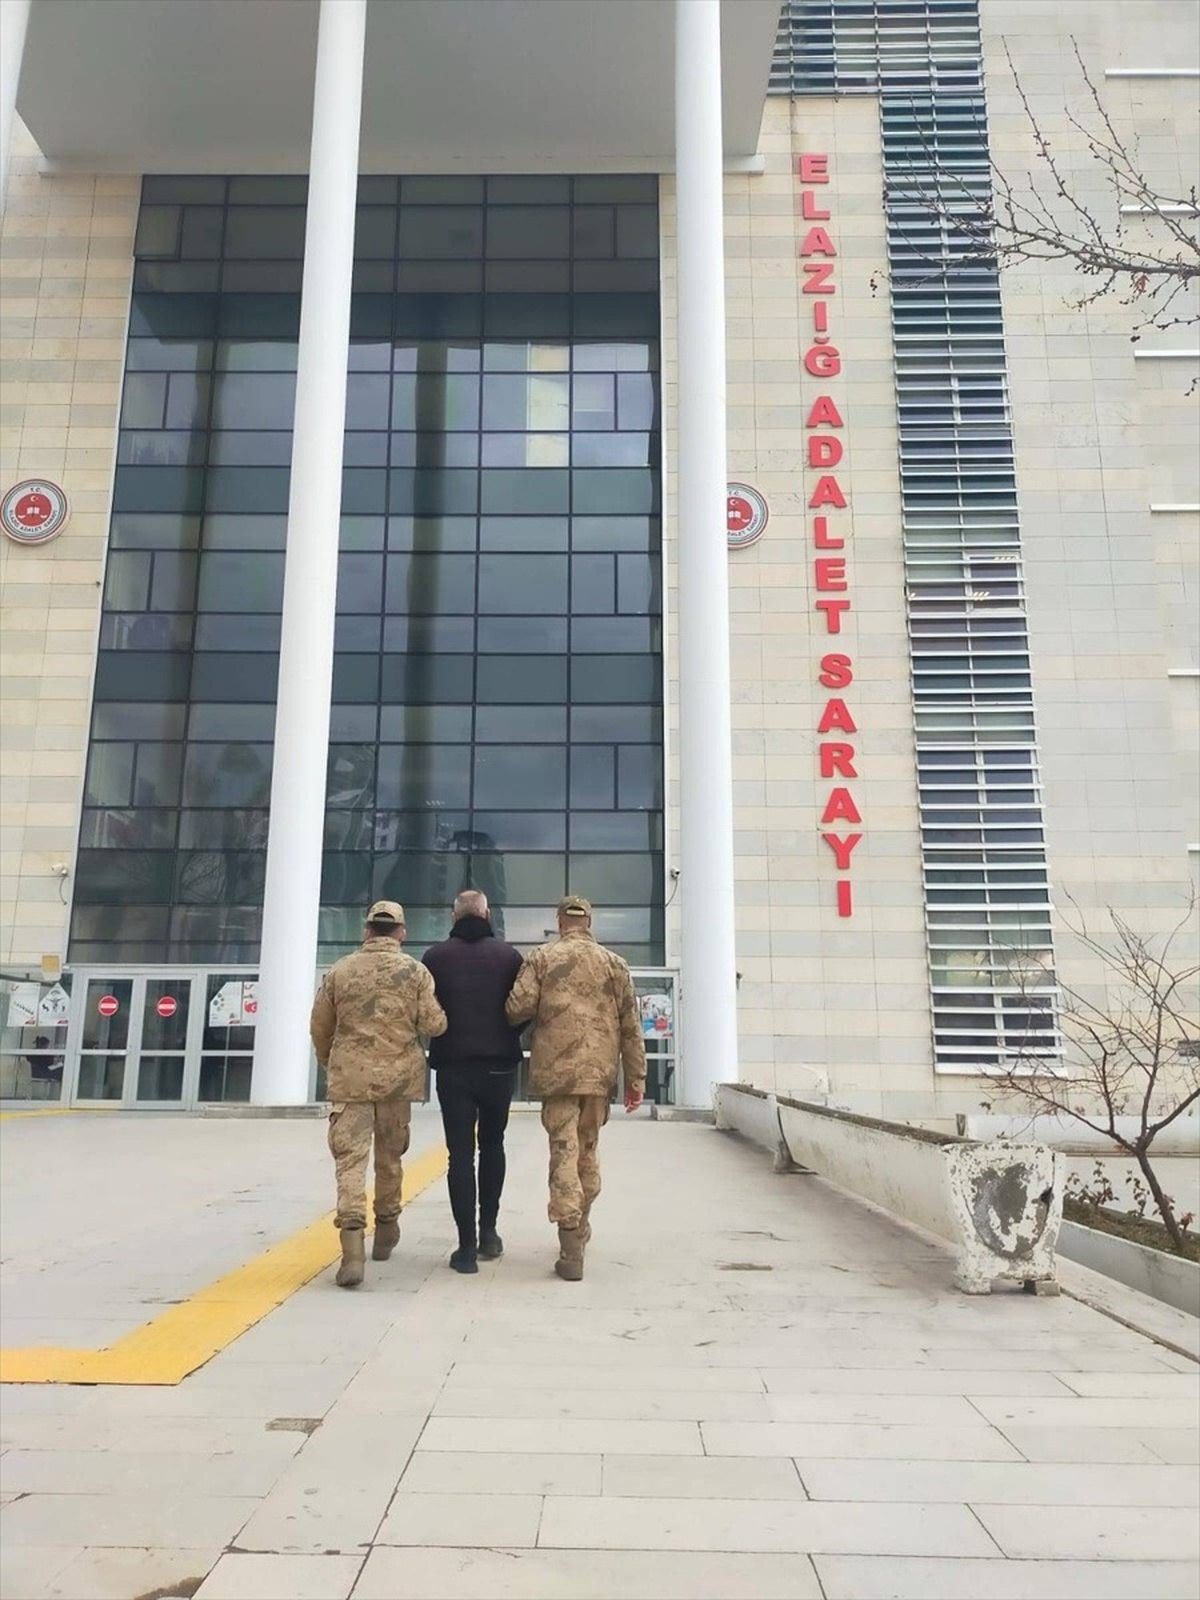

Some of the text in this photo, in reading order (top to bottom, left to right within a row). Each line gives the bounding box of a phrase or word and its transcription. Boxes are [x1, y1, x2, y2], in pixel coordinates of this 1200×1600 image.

[798, 152, 863, 918] ELAZIĞ ADALET SARAYI
